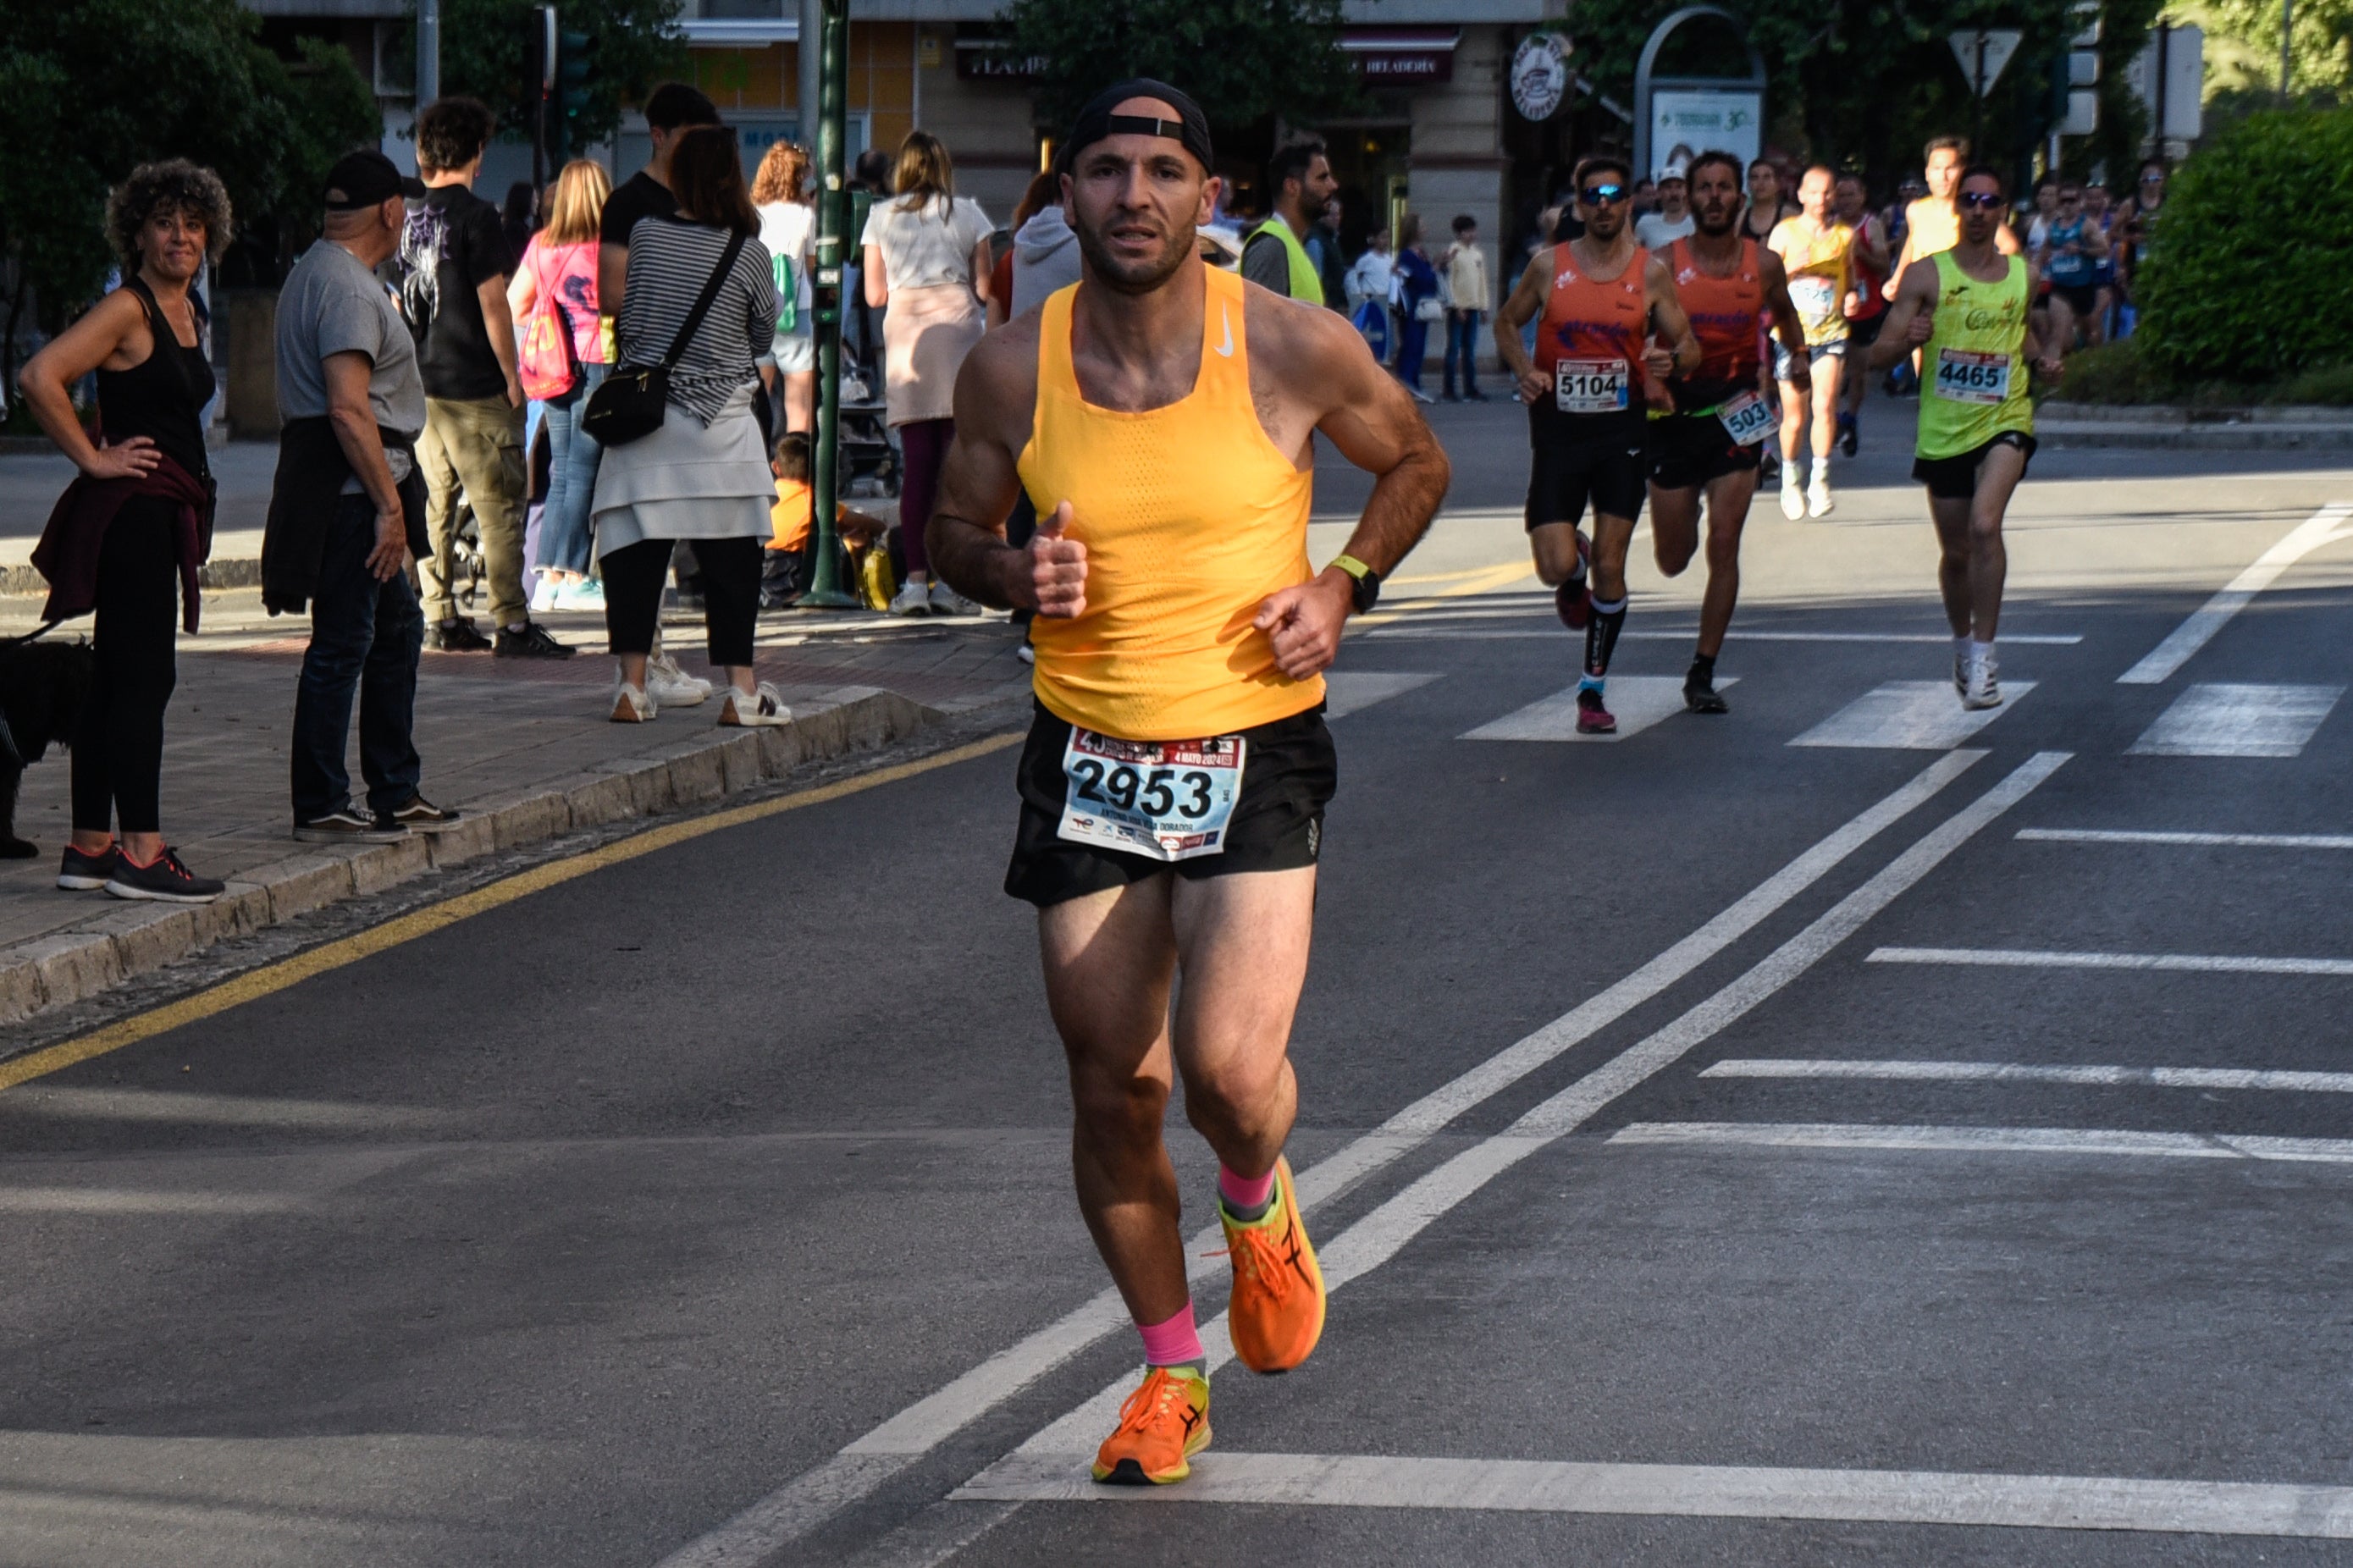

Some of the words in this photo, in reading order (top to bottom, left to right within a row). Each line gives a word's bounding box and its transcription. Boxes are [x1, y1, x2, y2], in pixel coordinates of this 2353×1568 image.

[1560, 375, 1618, 396] 5104
[1939, 362, 1999, 389] 4465
[1180, 752, 1202, 765] MAYO
[1202, 754, 1221, 765] 2024
[1072, 759, 1212, 820] 2953
